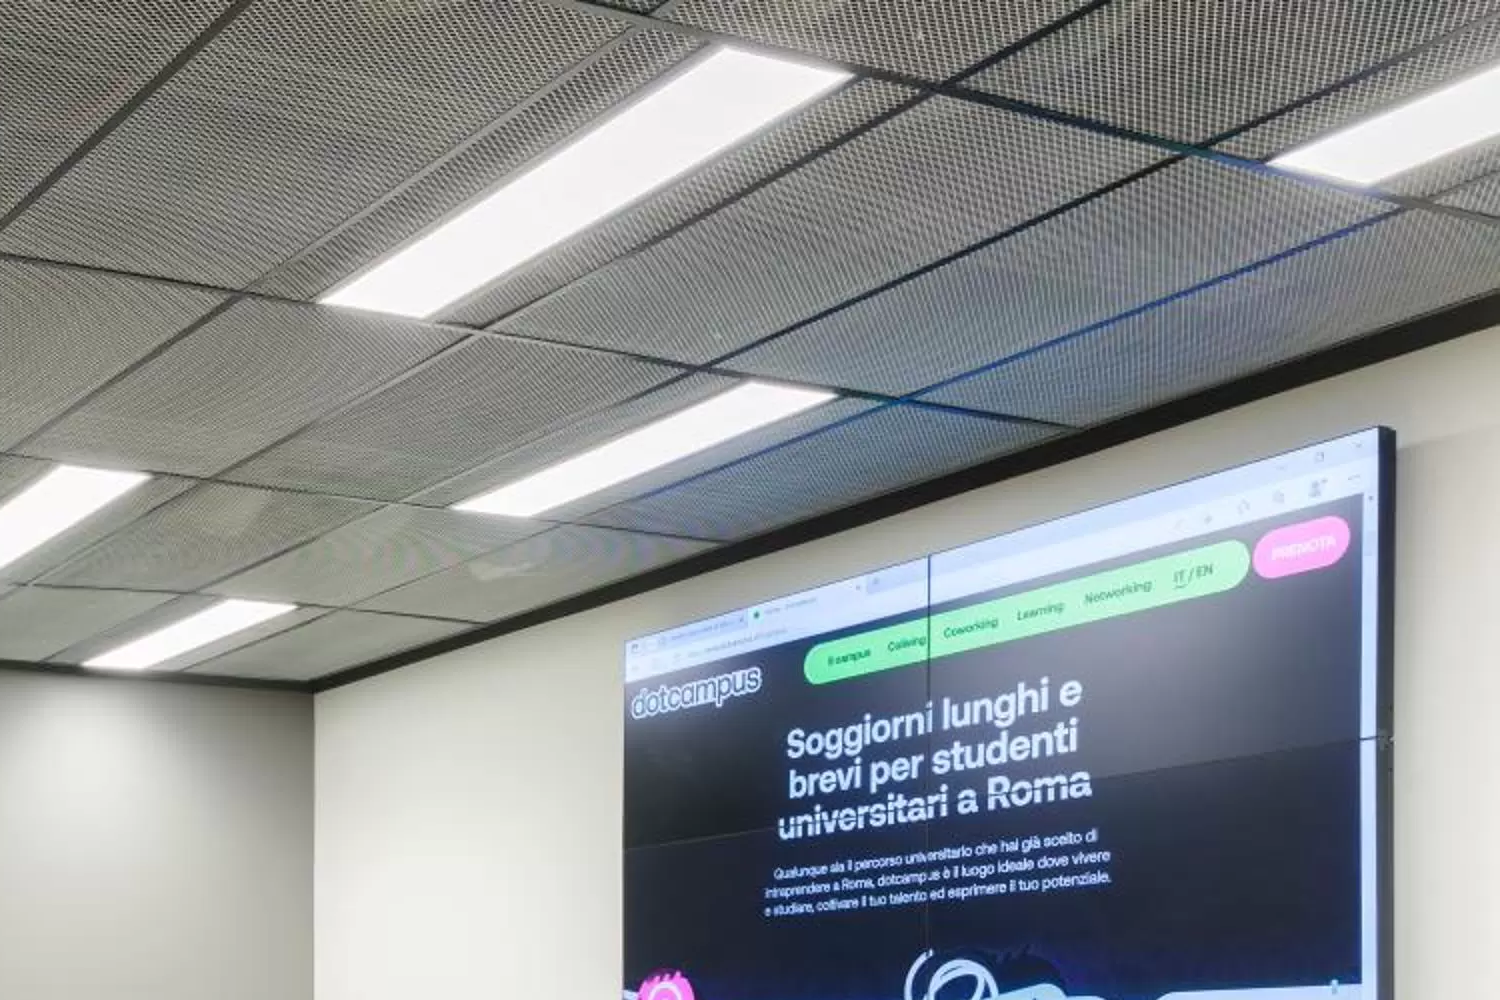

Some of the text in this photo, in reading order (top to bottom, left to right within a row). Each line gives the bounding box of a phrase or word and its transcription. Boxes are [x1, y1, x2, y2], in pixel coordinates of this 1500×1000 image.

[1271, 534, 1337, 561] PRENOTA
[1017, 602, 1065, 621] Learning
[1085, 579, 1153, 604] Networking
[943, 617, 999, 639] Coworking
[835, 648, 871, 665] campus
[631, 666, 763, 719] dotcampus
[786, 676, 1083, 760] Soggiorni lunghi e
[789, 716, 1079, 799] brevi per studenti
[777, 770, 1093, 841] universitari a Roma
[773, 828, 1098, 881] Qualunque sia il percorso universitario che hai già scelto di
[877, 869, 941, 888] dotcampus
[953, 865, 959, 878] il
[961, 863, 995, 879] luogo
[997, 857, 1035, 873] ideale
[1037, 855, 1069, 870] dove
[1071, 850, 1111, 866] vivere
[764, 906, 771, 918] e
[816, 898, 859, 912] coltivare
[861, 895, 867, 908] il
[869, 894, 887, 908] tuo
[889, 889, 928, 905] talento
[930, 886, 945, 900] ed
[947, 881, 1007, 901] esprimere
[1009, 879, 1017, 893] il
[1018, 878, 1039, 892] tuo
[1041, 869, 1112, 893] potenziale.
